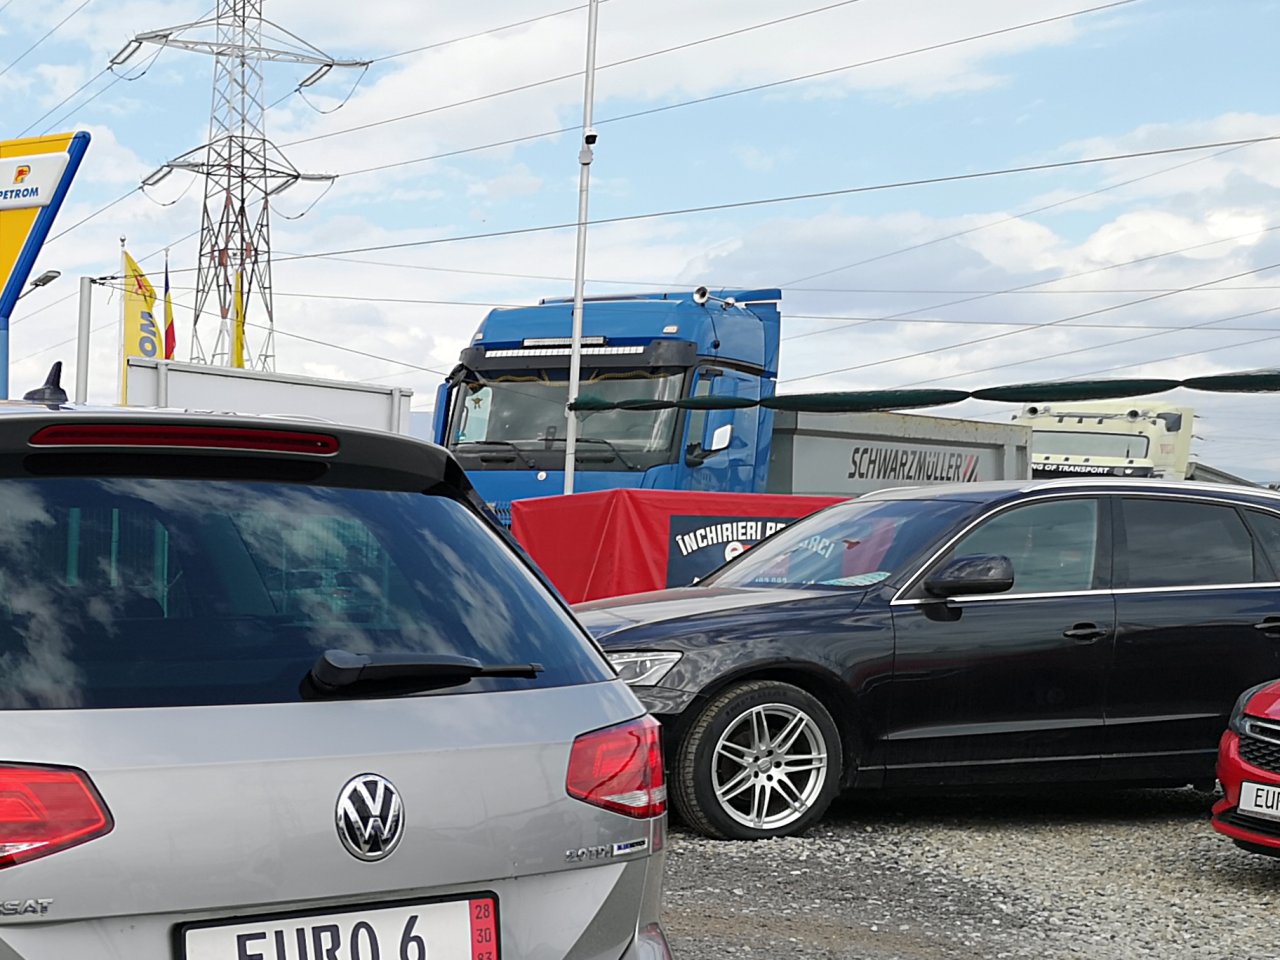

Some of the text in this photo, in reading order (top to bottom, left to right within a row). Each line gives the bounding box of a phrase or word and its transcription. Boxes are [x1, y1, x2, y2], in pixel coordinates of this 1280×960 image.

[848, 447, 962, 482] SCHWARZMÜLLER
[1058, 465, 1110, 474] TRANSPORT
[676, 521, 762, 556] ÎNCHIRIERI
[1253, 788, 1280, 811] EU
[474, 904, 490, 920] 28
[476, 927, 492, 944] 30
